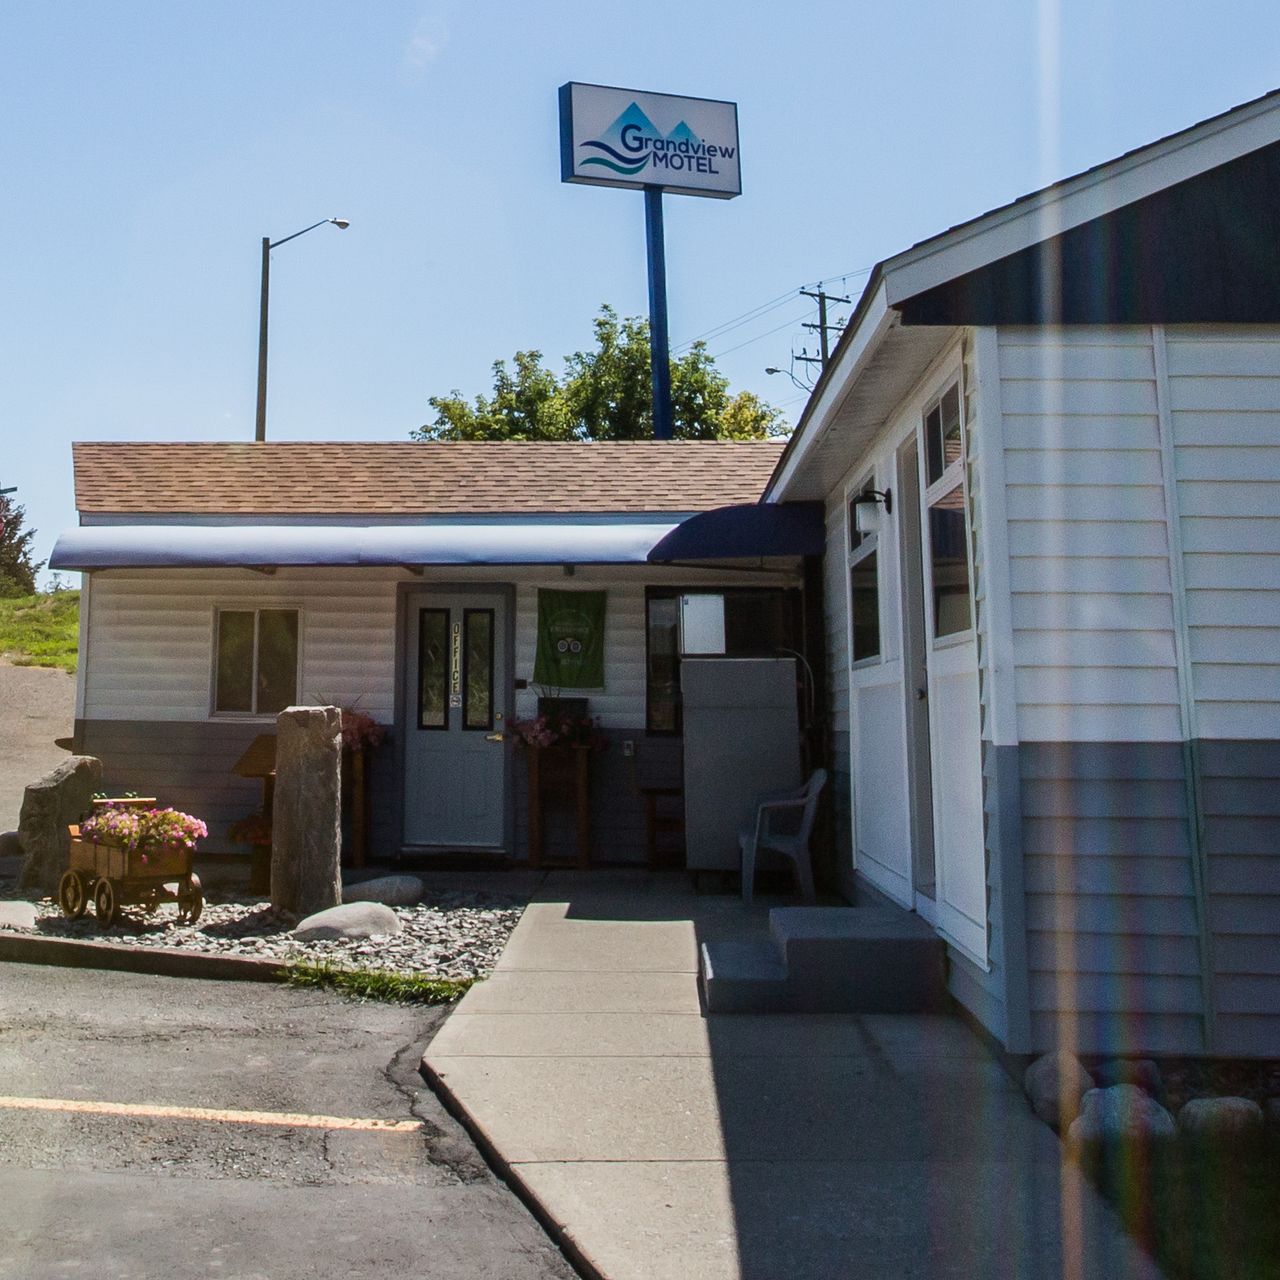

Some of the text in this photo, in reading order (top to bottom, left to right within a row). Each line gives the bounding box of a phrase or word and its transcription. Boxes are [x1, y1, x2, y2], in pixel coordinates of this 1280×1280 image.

[620, 124, 735, 159] Grandview
[652, 151, 719, 175] MOTEL
[452, 623, 460, 693] OFFICE
